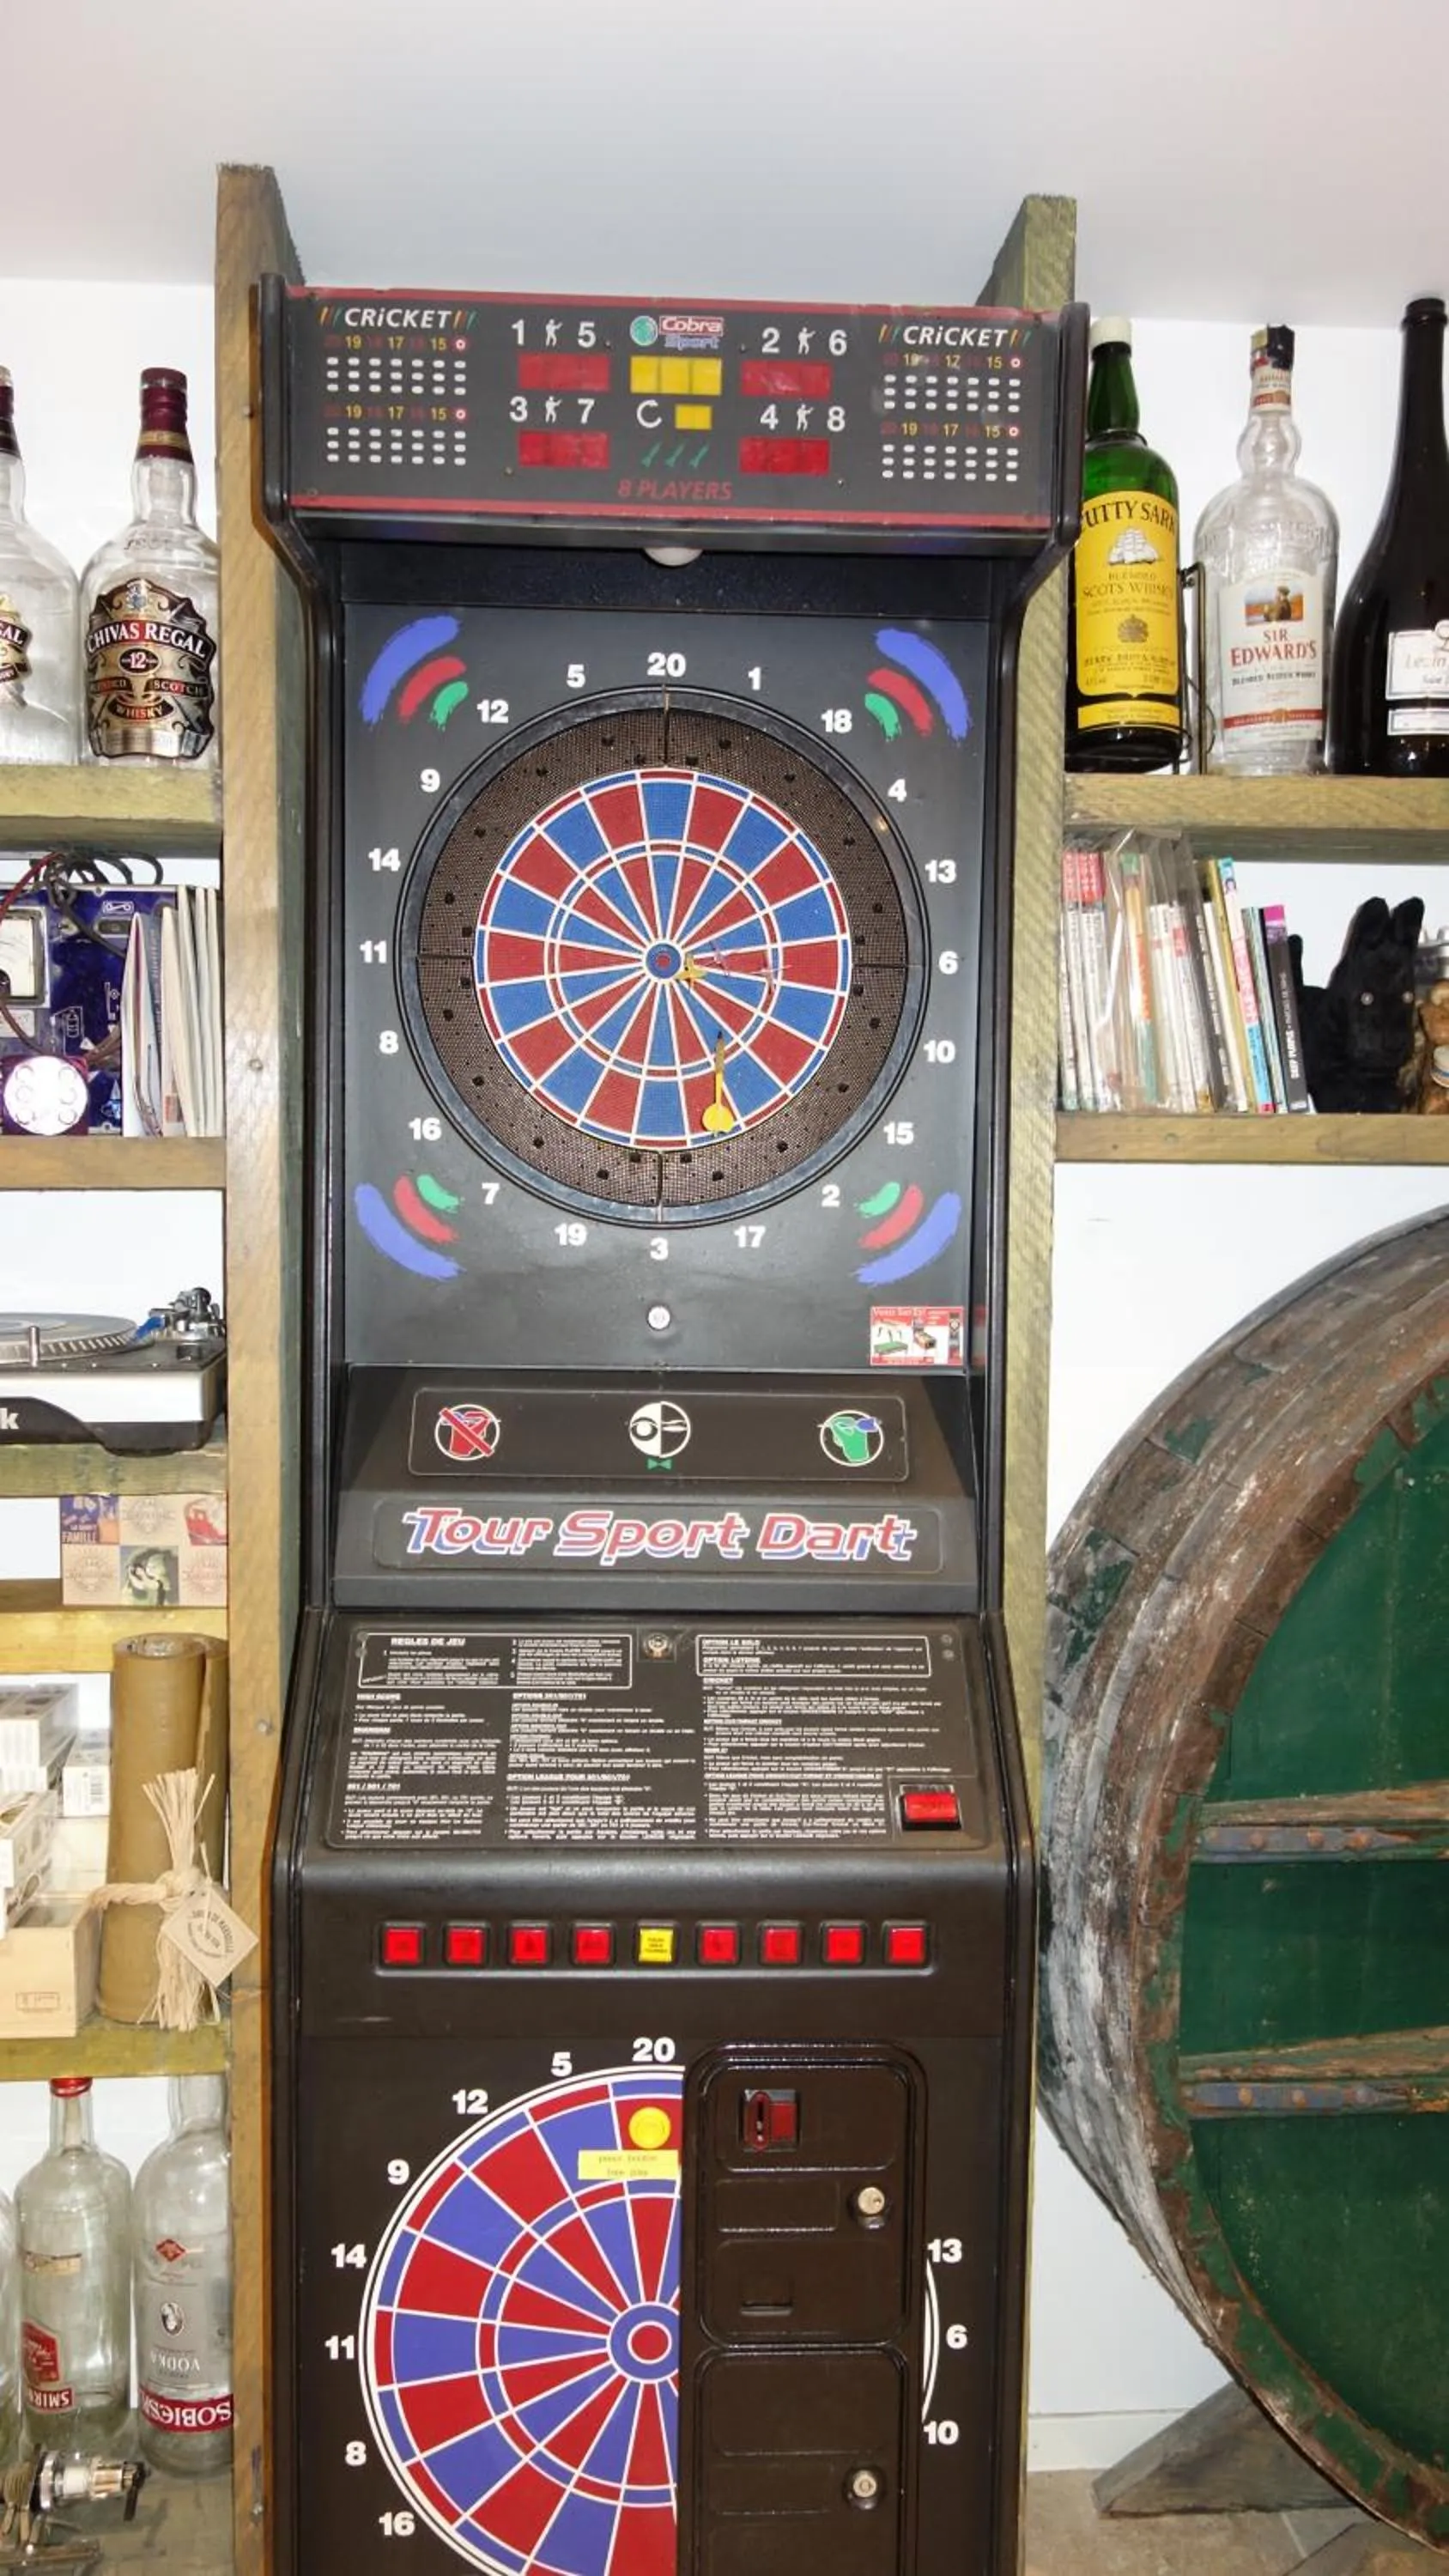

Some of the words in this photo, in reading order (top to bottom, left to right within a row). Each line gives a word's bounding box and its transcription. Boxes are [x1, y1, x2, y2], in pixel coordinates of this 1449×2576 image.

[512, 319, 524, 345] 1
[578, 322, 596, 348] 5
[662, 318, 722, 332] Cobra
[345, 335, 362, 349] 19
[388, 337, 404, 350] 17
[431, 337, 447, 351] 15
[761, 327, 780, 353] 2
[828, 329, 847, 355] 6
[988, 356, 1003, 369] 15
[345, 404, 362, 419] 19
[388, 406, 404, 420] 17
[431, 407, 447, 421] 15
[509, 396, 528, 422] 3
[578, 398, 595, 424] 7
[636, 399, 662, 428] C
[760, 404, 779, 429] 4
[827, 406, 846, 432] 8
[902, 422, 918, 436] 19
[943, 423, 959, 437] 17
[618, 478, 632, 497] 8
[637, 479, 733, 501] PLAYERS
[1081, 501, 1138, 532] UTTY
[88, 622, 140, 653] CHIVAS
[144, 625, 206, 659] REGAL
[1263, 629, 1289, 642] SIR
[130, 652, 146, 669] 12
[647, 652, 687, 677] 20
[1230, 640, 1317, 668] EDWARD'S
[567, 664, 585, 689] 5
[748, 666, 761, 690] 1
[116, 704, 163, 719] WHISKY
[476, 699, 509, 724] 12
[821, 708, 852, 733] 18
[420, 769, 440, 793] 9
[888, 778, 907, 802] 4
[368, 848, 401, 872] 14
[925, 860, 957, 884] 13
[360, 940, 387, 963] 11
[938, 951, 958, 975] 6
[379, 1030, 399, 1054] 8
[923, 1040, 956, 1064] 10
[409, 1117, 442, 1141] 16
[883, 1121, 914, 1145] 15
[482, 1182, 500, 1205] 7
[822, 1184, 840, 1207] 2
[555, 1222, 588, 1247] 19
[734, 1225, 766, 1249] 17
[650, 1236, 669, 1261] 3
[403, 1506, 552, 1555] Tour
[555, 1510, 749, 1566] Sport
[756, 1513, 919, 1561] Dart
[632, 2037, 676, 2063] 20
[550, 2051, 573, 2077] 5
[452, 2089, 488, 2115] 12
[387, 2159, 409, 2185] 9
[330, 2243, 367, 2269] 14
[927, 2239, 962, 2263] 13
[324, 2335, 355, 2360] 11
[946, 2324, 967, 2349] 6
[149, 2352, 200, 2371] VODKA
[923, 2421, 959, 2445] 10
[345, 2440, 367, 2466] 8
[379, 2511, 415, 2537] 16
